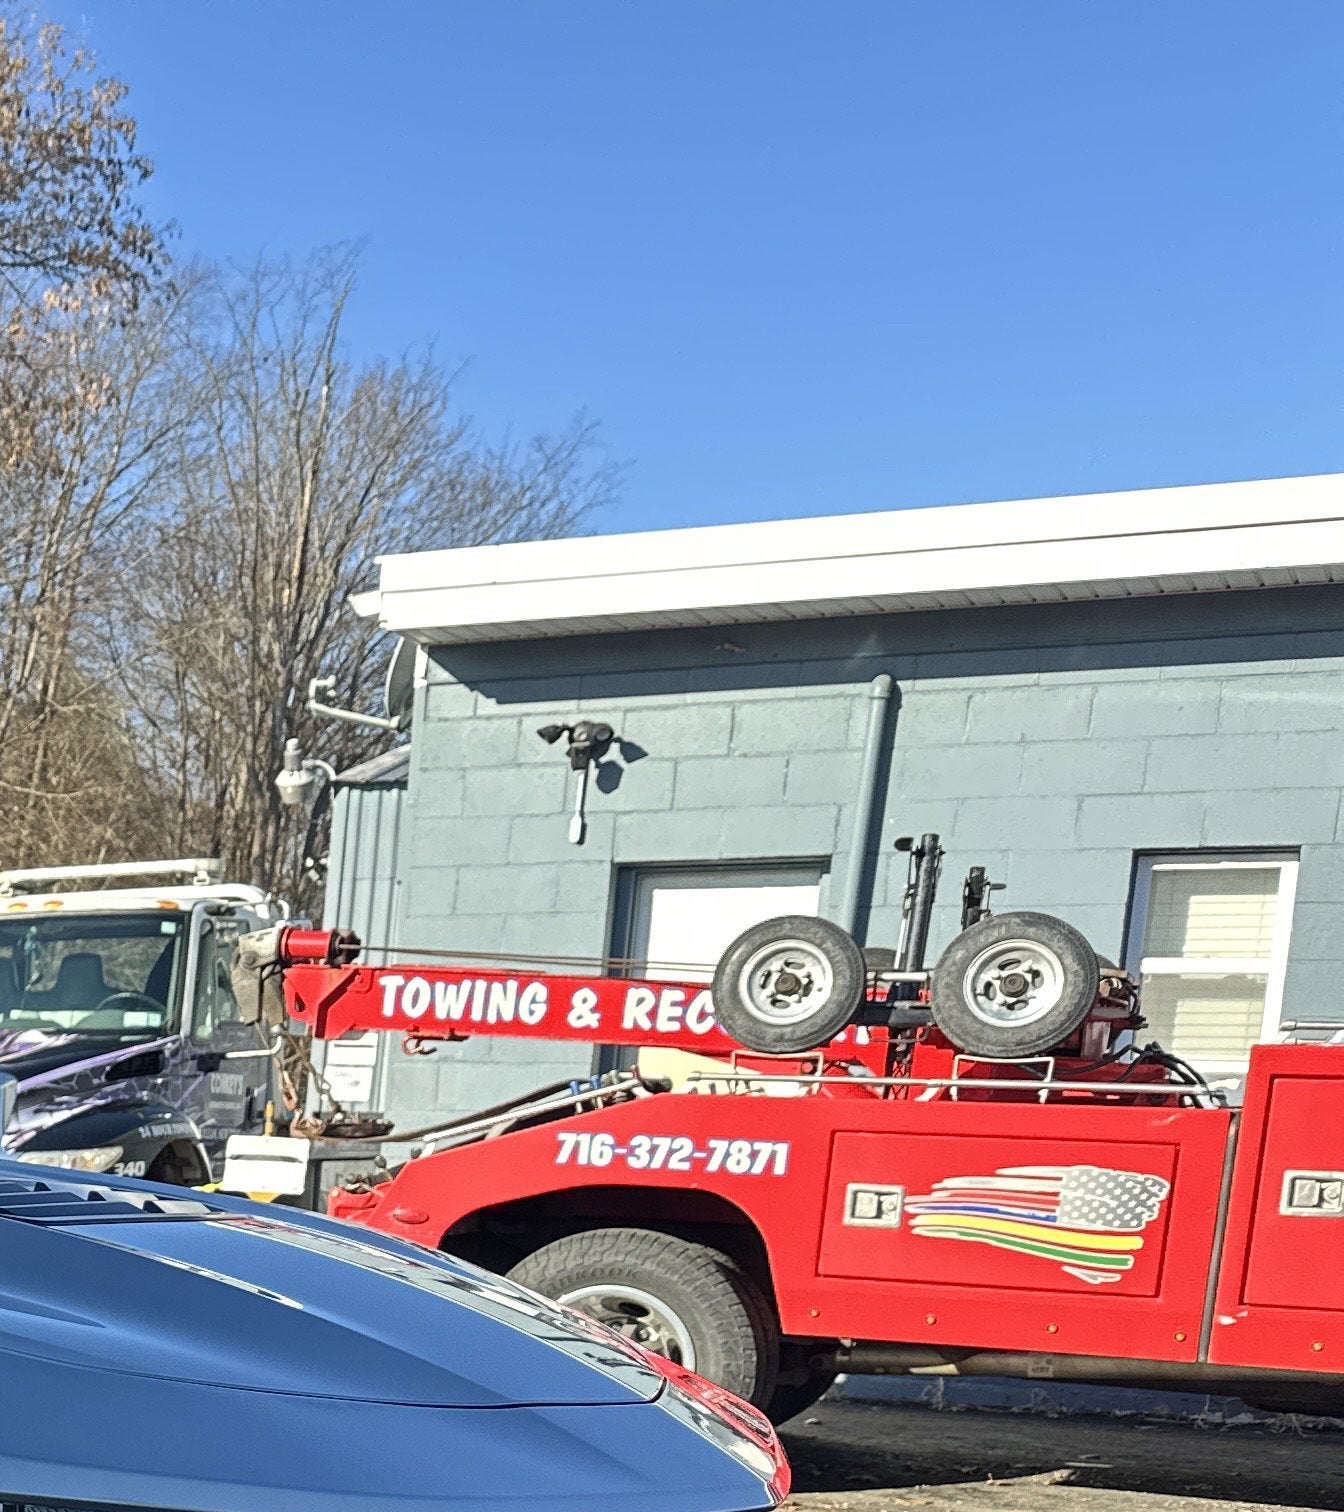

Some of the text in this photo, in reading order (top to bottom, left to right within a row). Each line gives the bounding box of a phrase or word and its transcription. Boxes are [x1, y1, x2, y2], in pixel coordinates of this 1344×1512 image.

[378, 974, 718, 1034] TOWING & REC
[114, 1160, 146, 1178] 340
[555, 1132, 790, 1176] 716-372-7871
